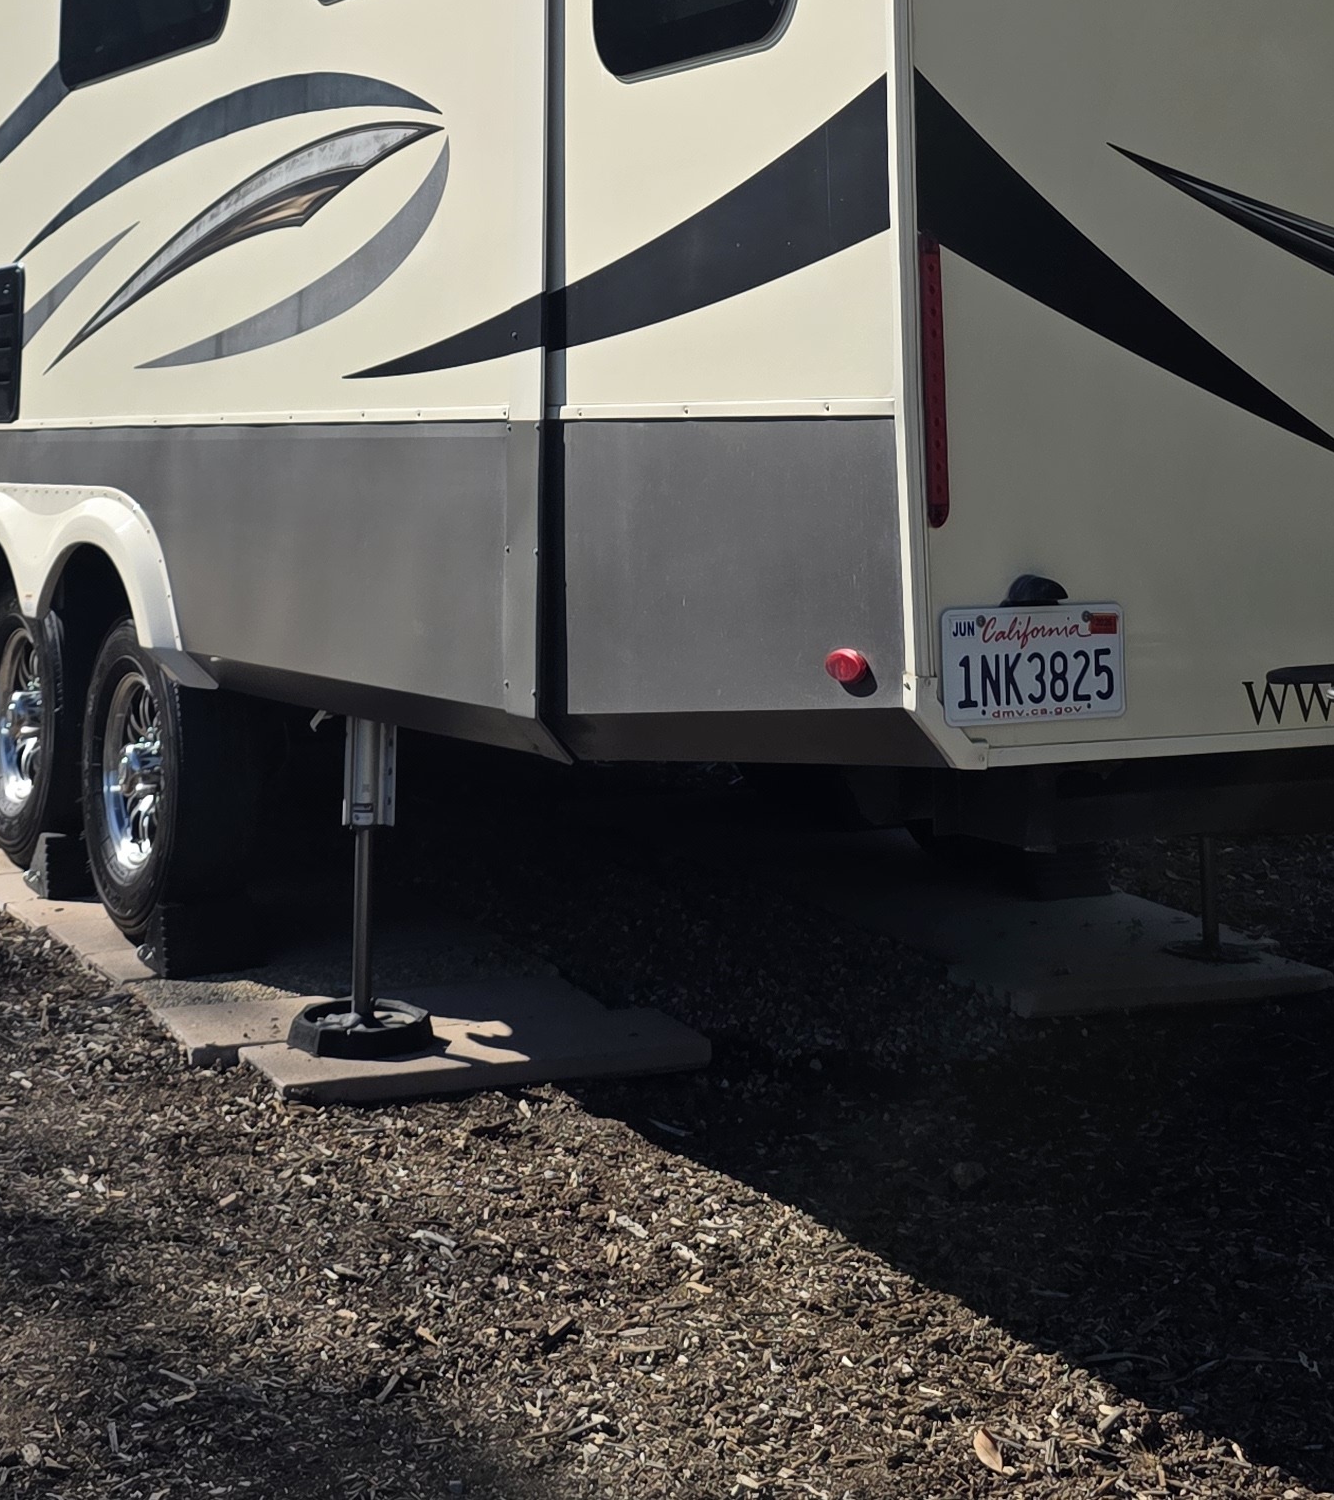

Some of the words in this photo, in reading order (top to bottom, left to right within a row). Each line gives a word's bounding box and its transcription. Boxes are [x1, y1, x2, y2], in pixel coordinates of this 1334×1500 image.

[952, 620, 975, 637] JUN
[981, 614, 1092, 650] California
[957, 647, 1115, 710] 1NK3825
[991, 704, 1083, 720] dmv.ca.gov
